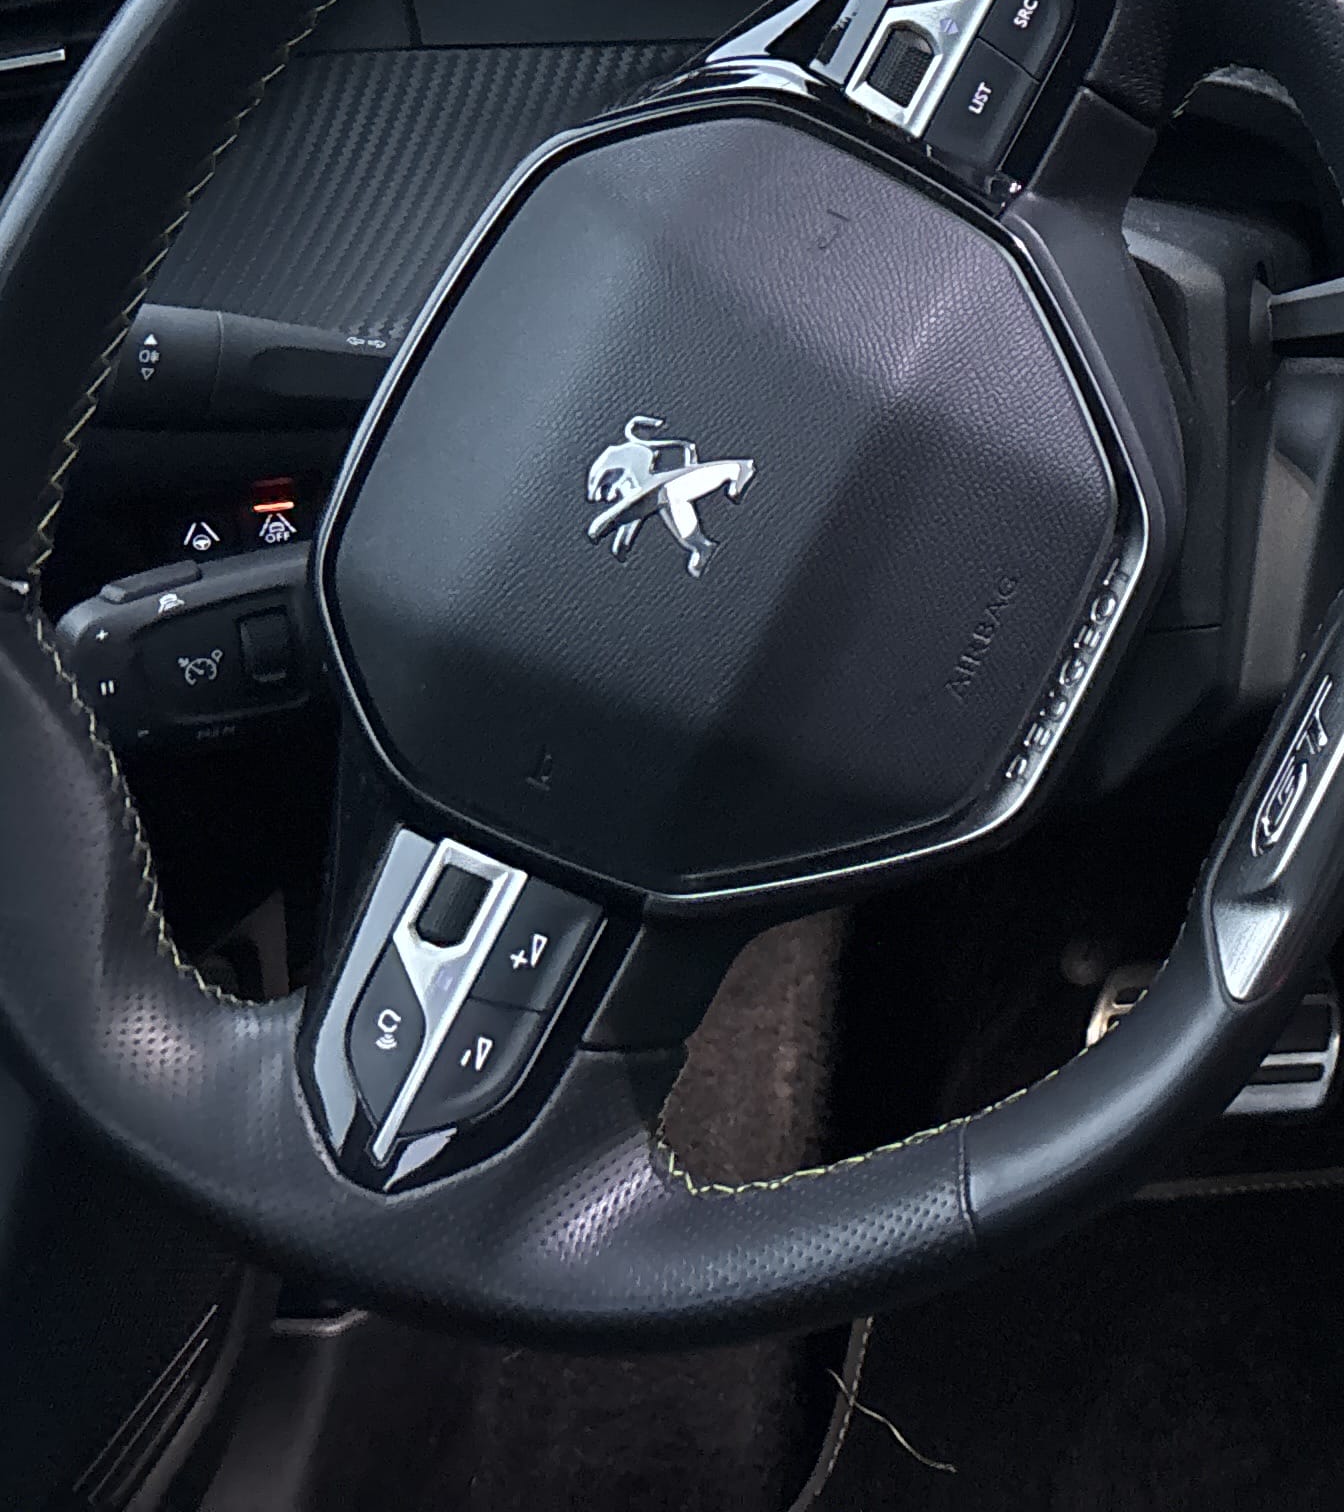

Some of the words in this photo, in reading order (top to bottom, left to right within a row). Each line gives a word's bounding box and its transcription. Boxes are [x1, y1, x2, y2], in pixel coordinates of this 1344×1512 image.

[968, 81, 993, 116] LIST
[265, 531, 290, 543] OFF
[943, 574, 1020, 702] AIRBAG
[1004, 558, 1134, 782] PEUGEOT
